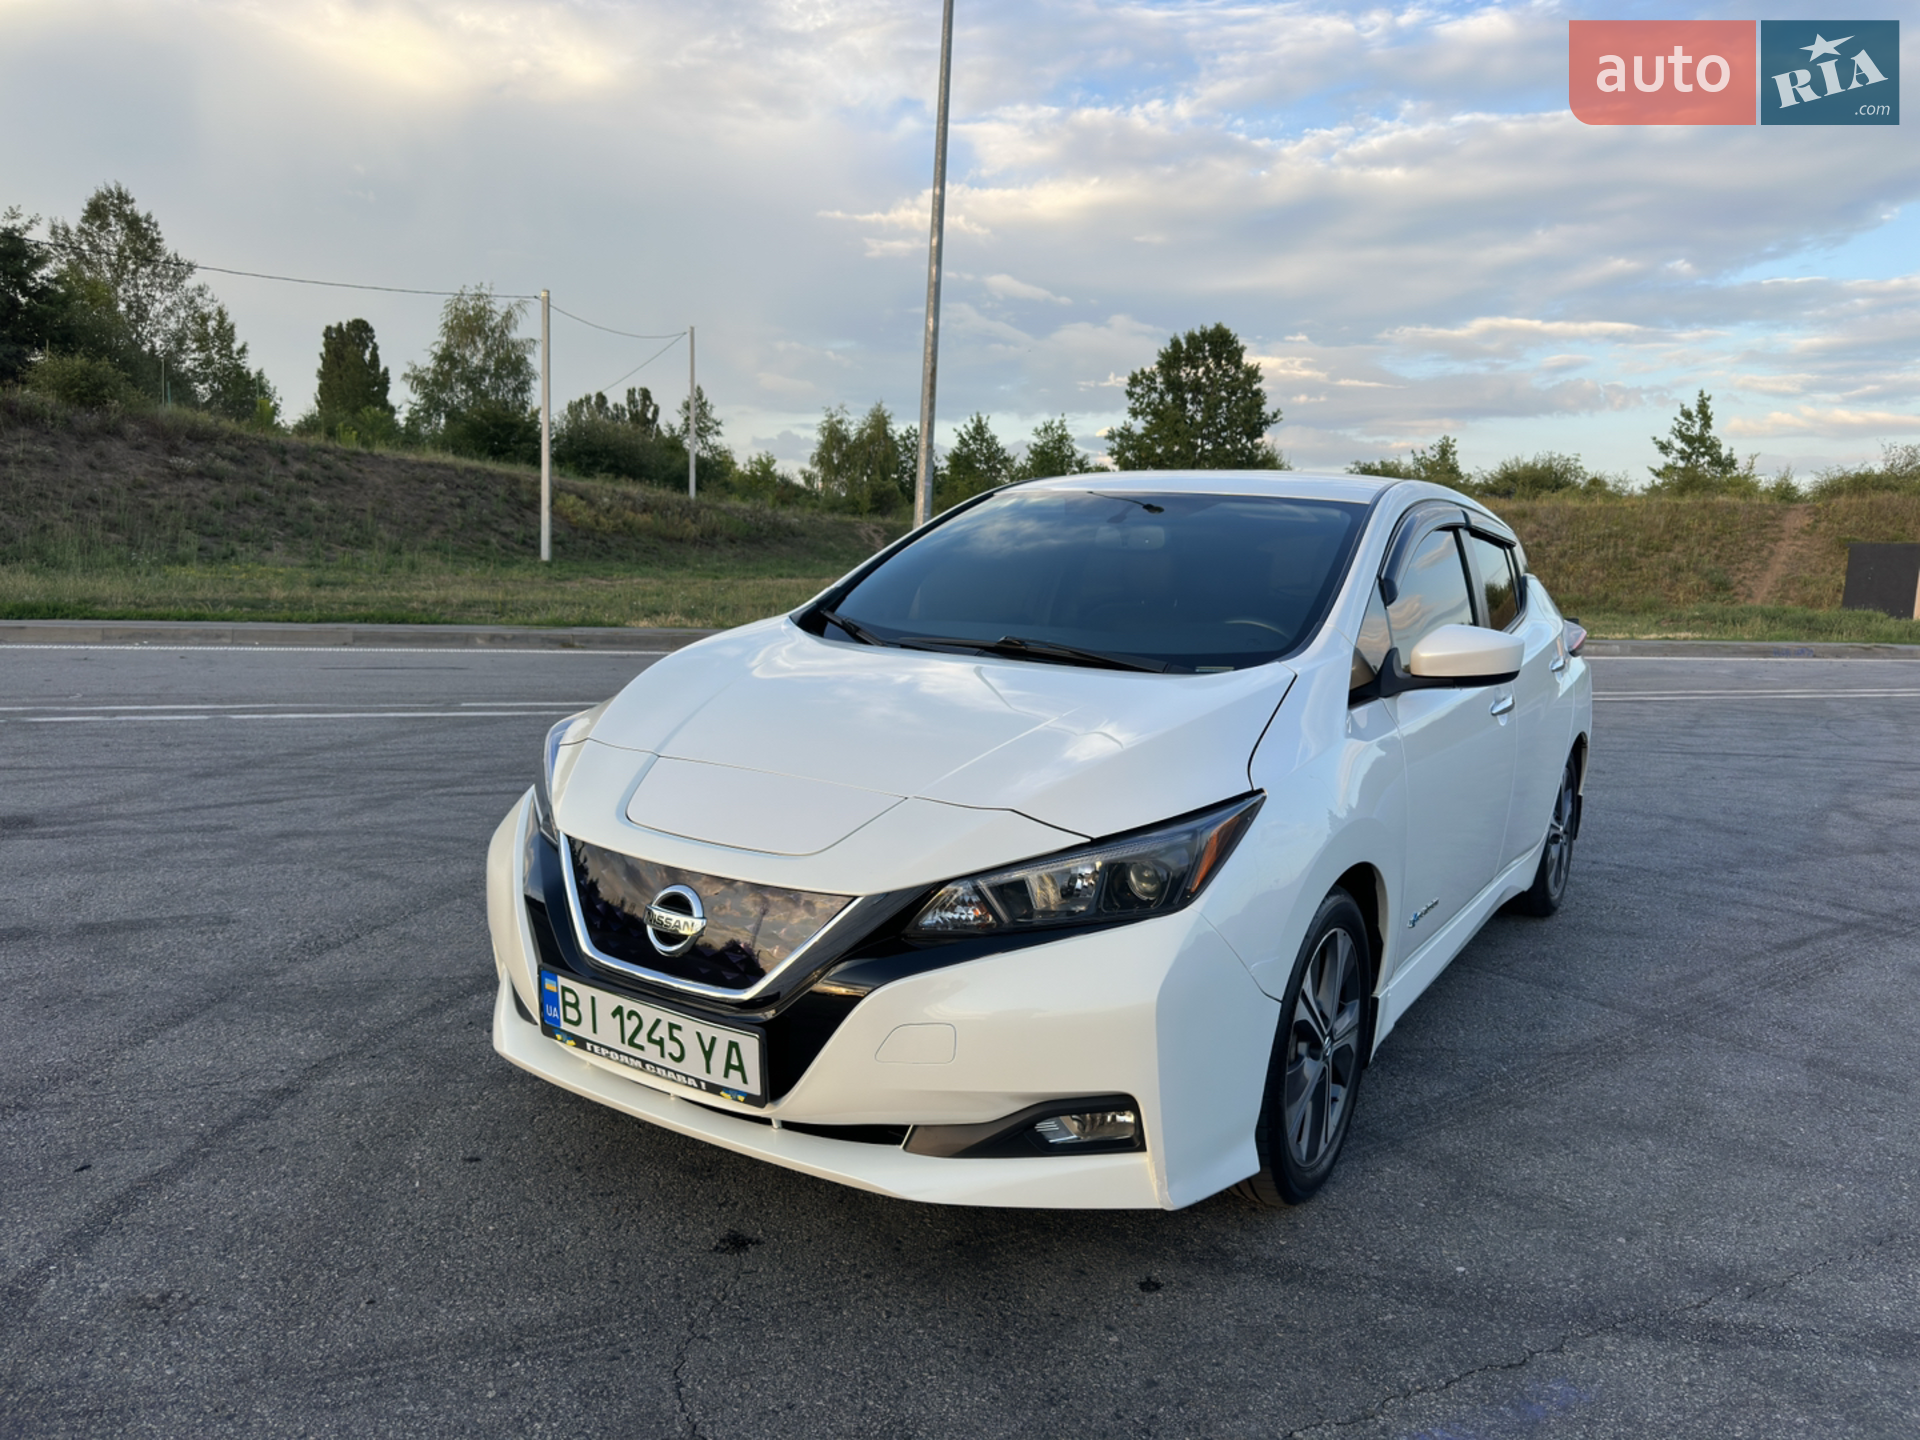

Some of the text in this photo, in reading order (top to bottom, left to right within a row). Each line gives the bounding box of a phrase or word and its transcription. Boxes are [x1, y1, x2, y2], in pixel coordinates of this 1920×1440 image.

[646, 910, 695, 932] NISSAN
[546, 1004, 559, 1019] UA
[586, 1042, 642, 1068] ГЕРОЯМ
[611, 1004, 686, 1064] 1245
[696, 1031, 748, 1085] YA
